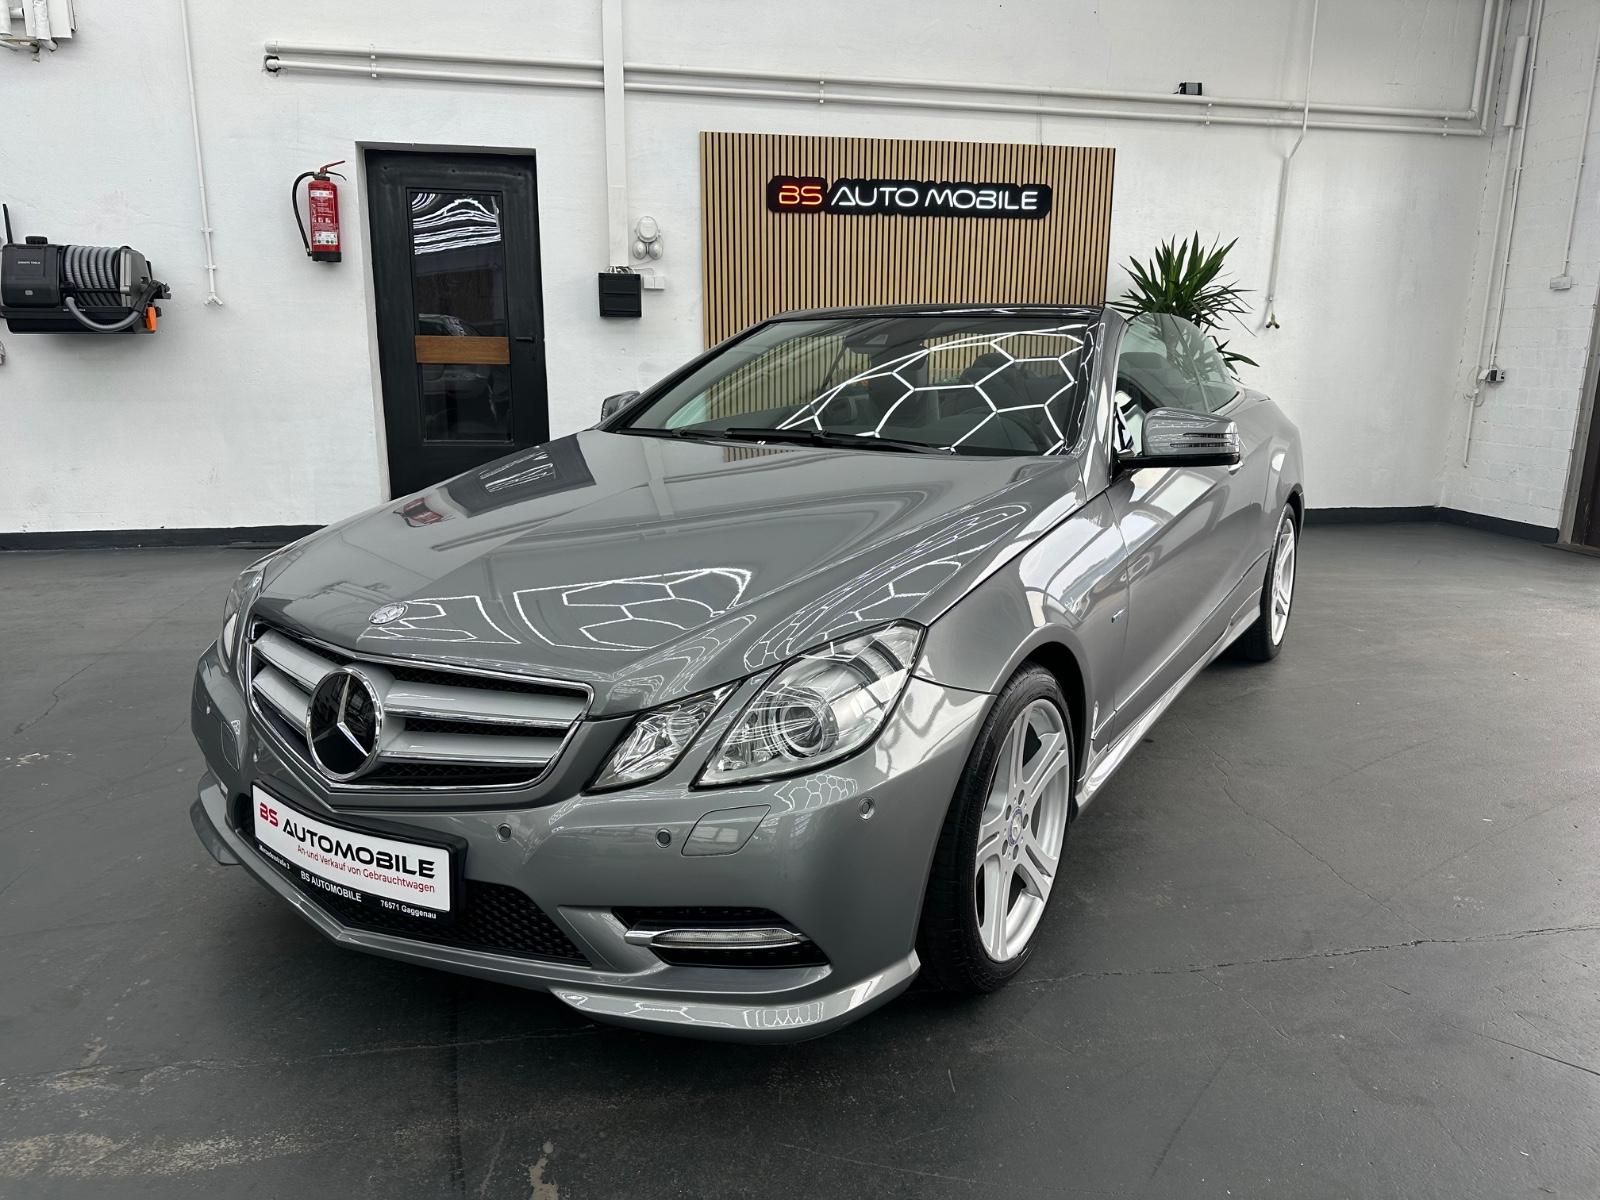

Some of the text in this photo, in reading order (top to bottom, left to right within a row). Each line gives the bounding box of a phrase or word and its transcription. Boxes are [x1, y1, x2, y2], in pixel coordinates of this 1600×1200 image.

[778, 185, 1039, 211] BS AUTO MOBILE
[259, 801, 436, 880] BS AUTOMOBILE
[300, 870, 362, 903] BS AUTOMOBILE
[320, 853, 347, 872] Verkauf
[347, 865, 361, 876] von
[363, 868, 436, 894] Gebrauchtwagen
[380, 899, 437, 919] 76571 Gaggenau
